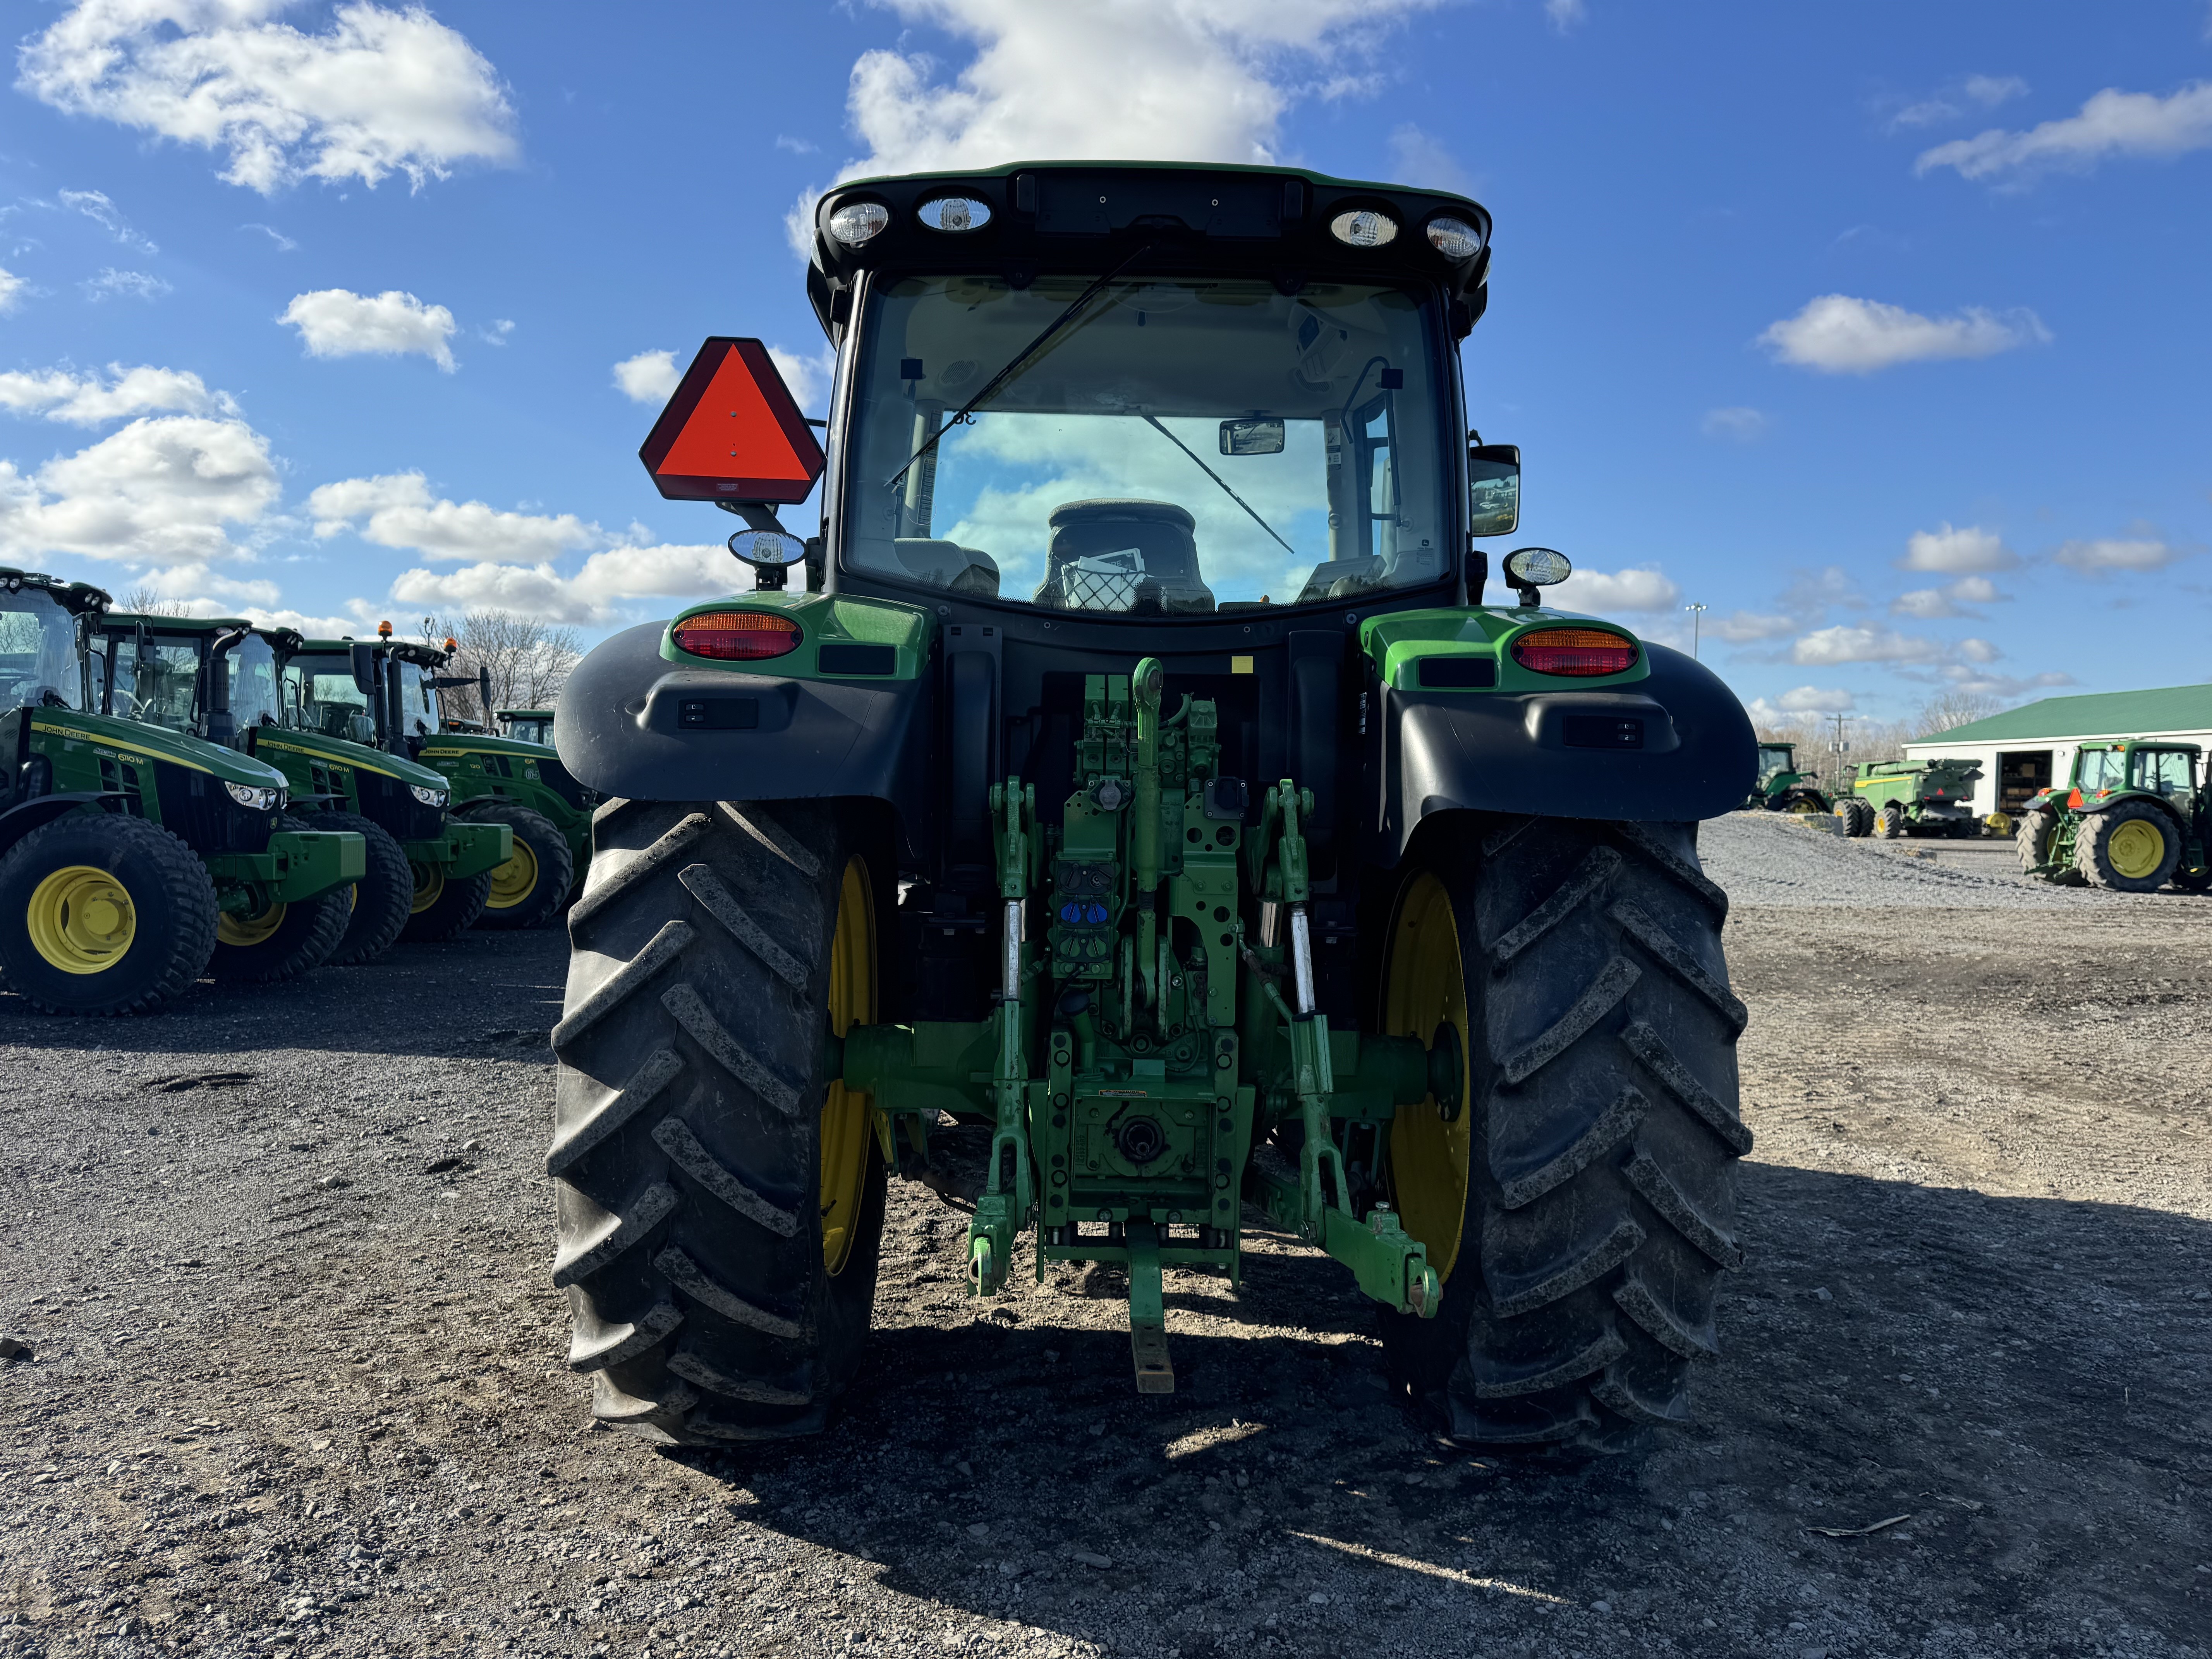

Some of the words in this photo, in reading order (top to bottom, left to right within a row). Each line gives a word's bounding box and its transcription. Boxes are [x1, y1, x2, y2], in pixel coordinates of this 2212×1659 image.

[42, 725, 63, 735] JOHN
[65, 729, 91, 740] DEERE
[283, 744, 304, 753] DEERE
